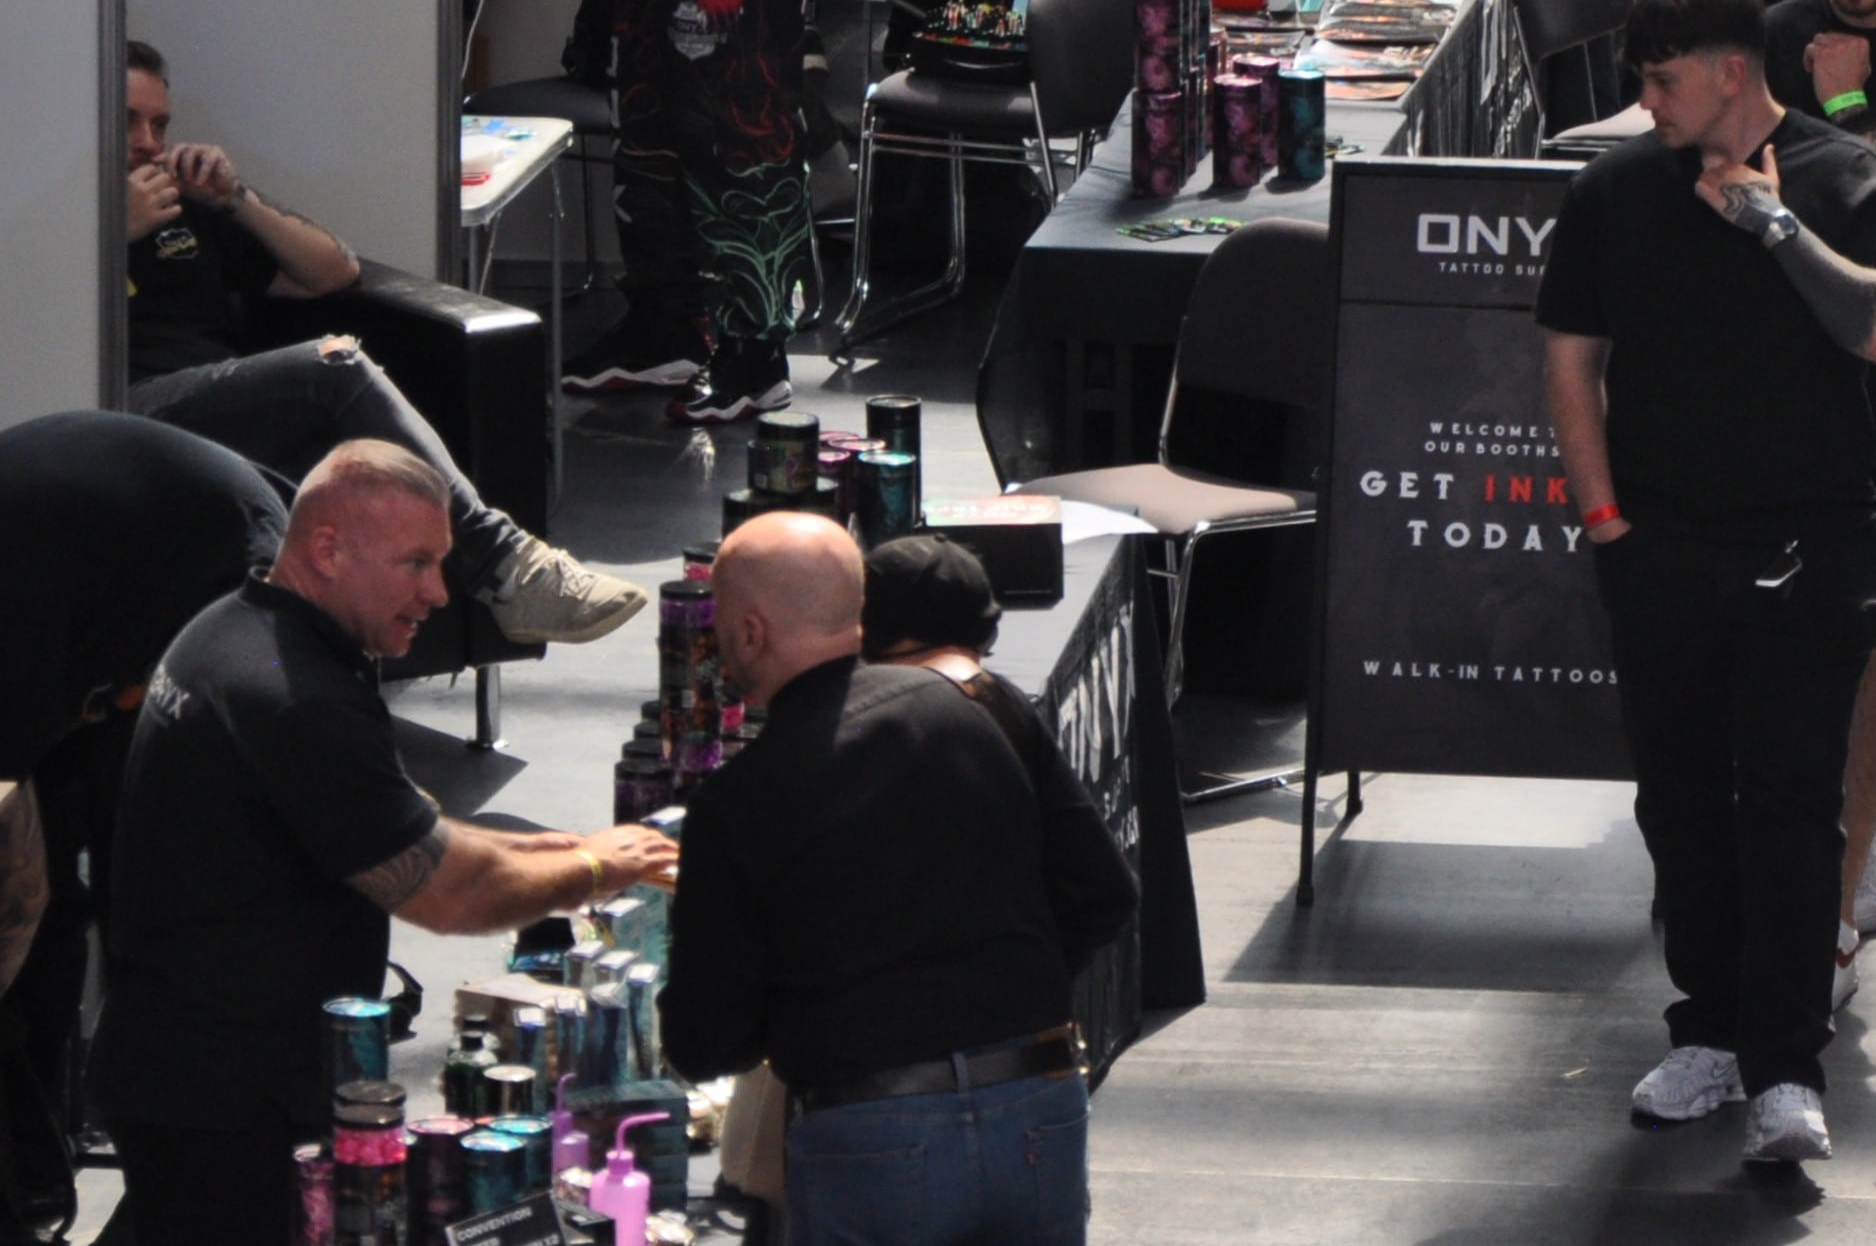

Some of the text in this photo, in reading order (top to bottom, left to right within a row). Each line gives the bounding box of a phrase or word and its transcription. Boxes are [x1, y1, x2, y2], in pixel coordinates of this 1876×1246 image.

[1417, 213, 1557, 256] ONY
[1439, 261, 1504, 275] TATTOO
[1430, 423, 1538, 438] WELCOME
[1424, 440, 1560, 457] OUR BOOTHS
[1360, 471, 1454, 500] GET
[1407, 520, 1584, 552] TODAY
[1363, 660, 1618, 684] WALK-IN TATTOOS
[457, 1207, 532, 1241] CONVENTION
